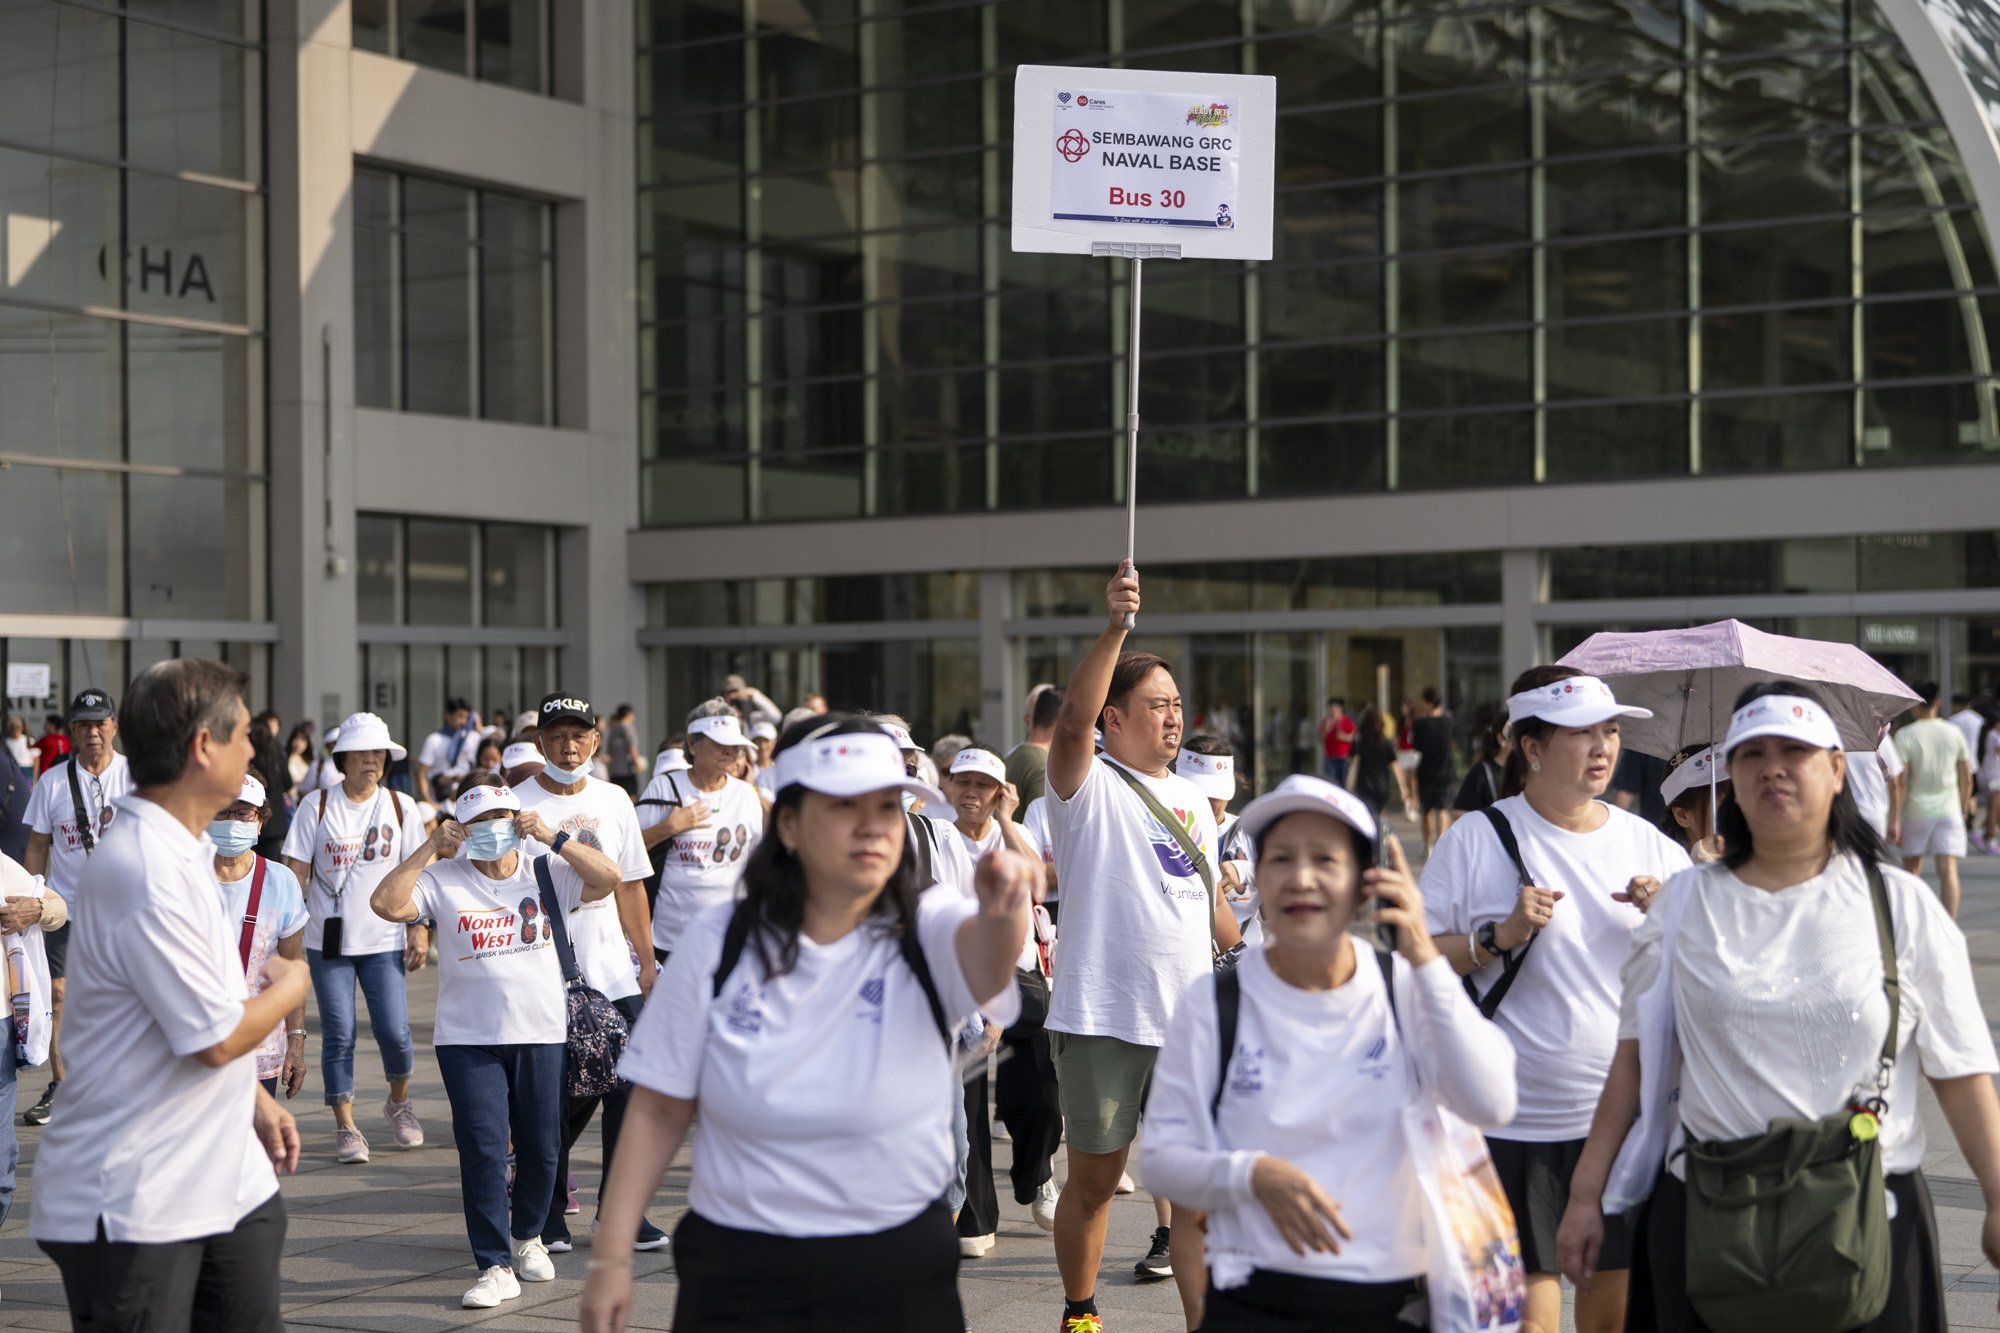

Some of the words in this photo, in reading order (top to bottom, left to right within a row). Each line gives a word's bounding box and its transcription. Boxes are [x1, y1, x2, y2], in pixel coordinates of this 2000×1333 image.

[1092, 131, 1194, 149] SEMBAWANG
[1199, 137, 1232, 151] GRC
[1102, 151, 1164, 169] NAVAL
[1169, 154, 1221, 172] BASE
[1109, 186, 1152, 207] Bus
[1160, 189, 1186, 208] 30
[543, 698, 589, 713] OAKLEY
[672, 839, 712, 850] NORTH
[680, 852, 708, 864] WEST
[457, 914, 515, 933] NORTH
[471, 931, 516, 951] WEST
[476, 950, 498, 960] BRISK
[498, 945, 531, 956] WALKING
